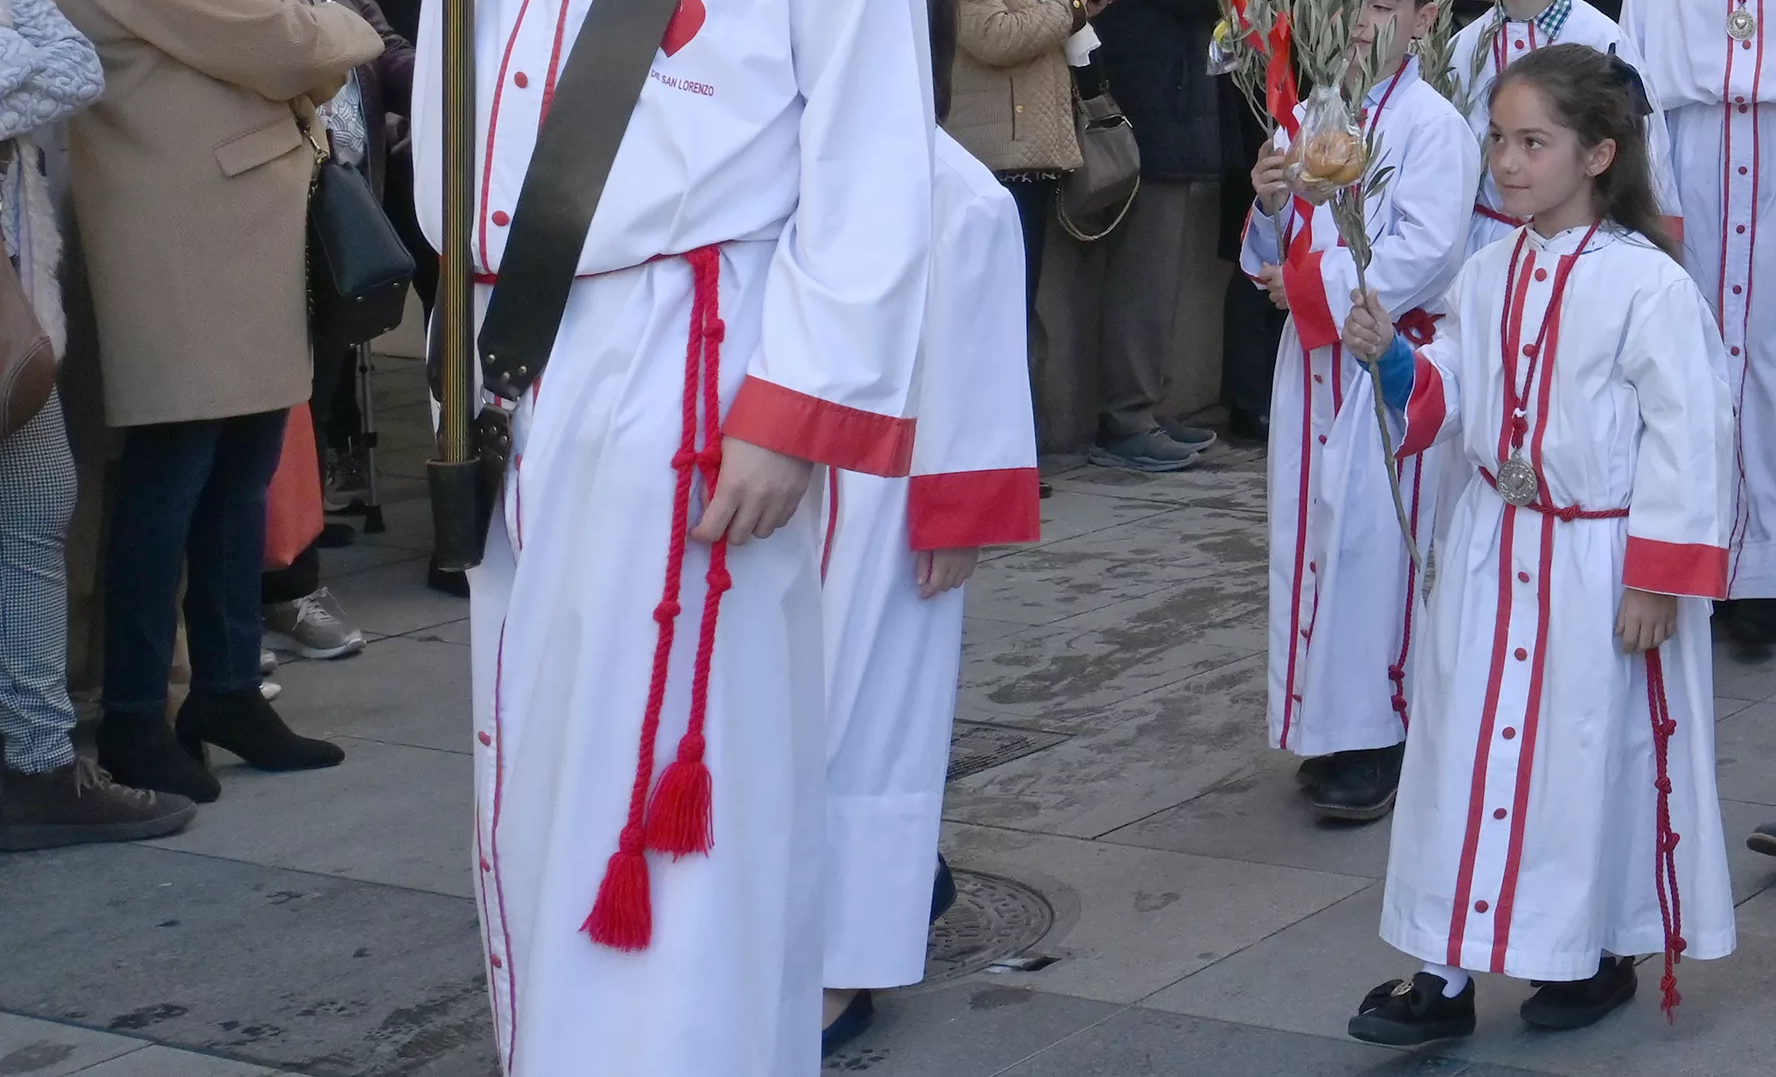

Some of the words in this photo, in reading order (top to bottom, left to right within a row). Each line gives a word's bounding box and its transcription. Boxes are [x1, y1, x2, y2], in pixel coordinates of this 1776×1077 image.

[650, 69, 661, 81] DE
[661, 74, 678, 88] SAN
[677, 80, 715, 97] LORENZO
